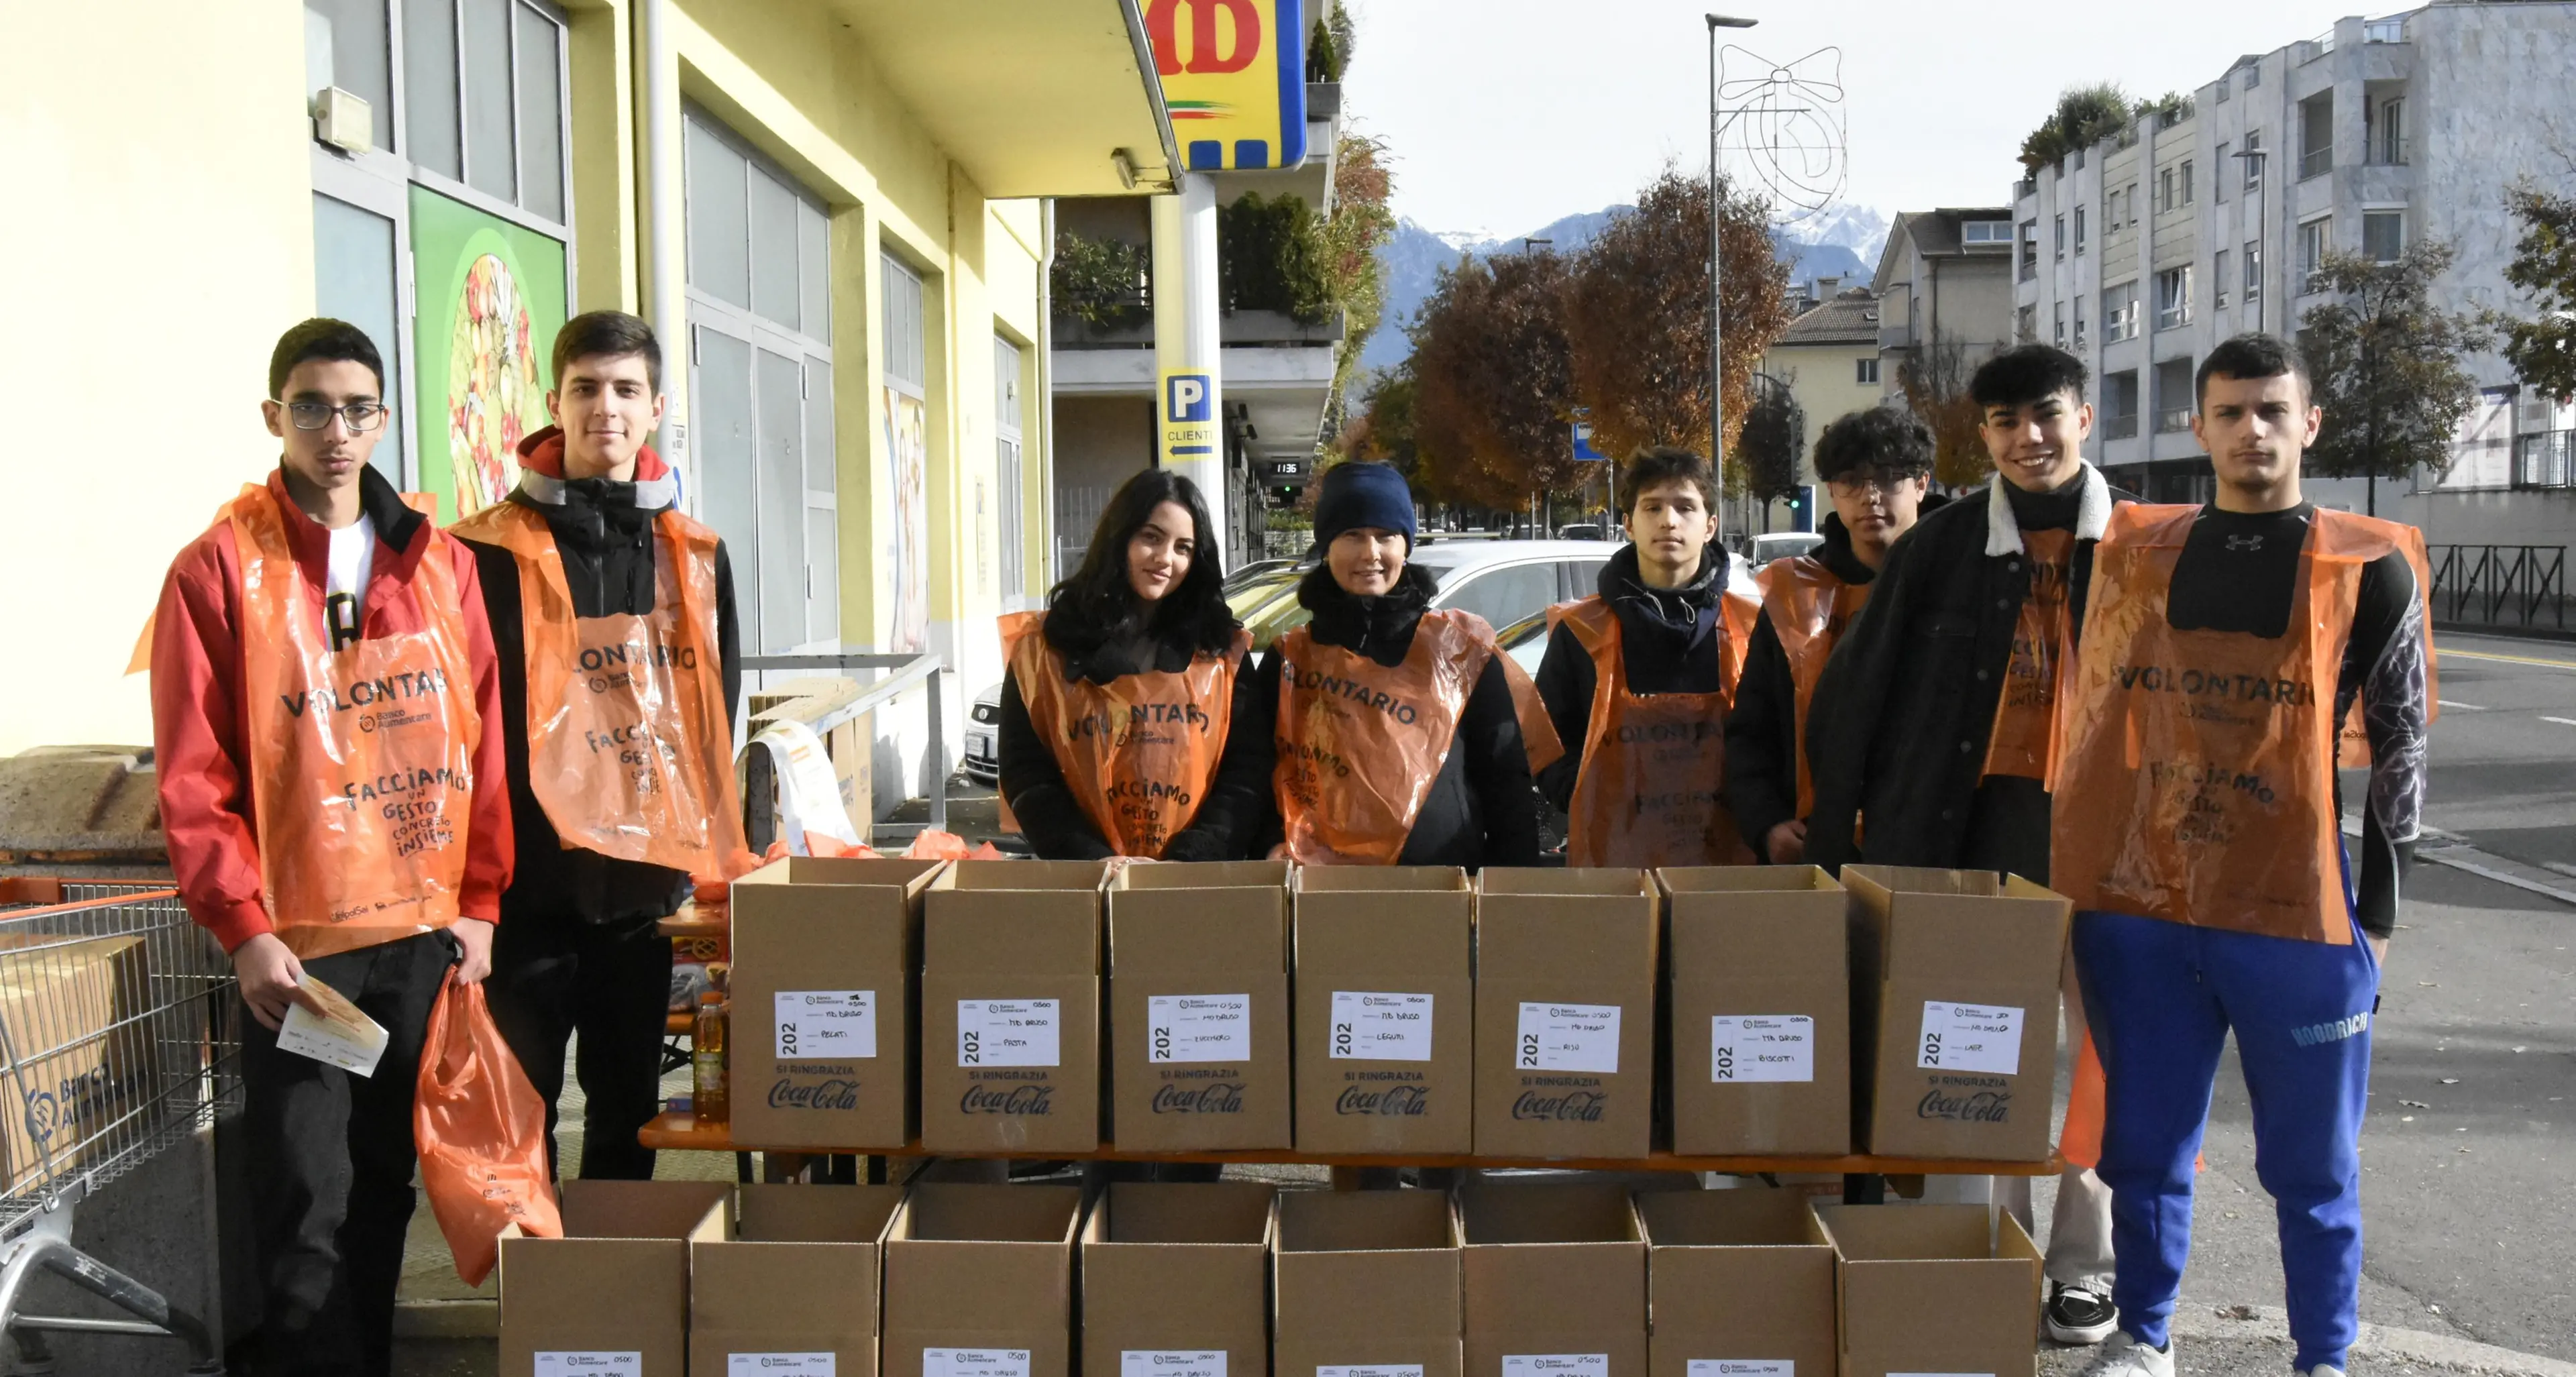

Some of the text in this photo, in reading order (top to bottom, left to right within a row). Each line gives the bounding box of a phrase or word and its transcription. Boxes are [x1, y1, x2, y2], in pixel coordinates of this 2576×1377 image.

[1174, 380, 1203, 417] P
[1167, 430, 1213, 441] CLIENTI
[408, 789, 425, 800] UN
[382, 801, 436, 822] GESTO
[393, 815, 450, 840] CONCRETO
[782, 1023, 797, 1055] 202
[965, 1032, 979, 1063] 202
[1155, 1028, 1170, 1059] 202
[1336, 1023, 1352, 1055] 202
[1523, 1034, 1538, 1066] 202
[1924, 1033, 1941, 1065] 202
[776, 1065, 855, 1075] SI RINGRAZIA
[969, 1071, 1047, 1081] SI RINGRAZIA
[1160, 1069, 1238, 1079] SI RINGRAZIA
[1344, 1072, 1424, 1081] SI RINGRAZIA
[1718, 1046, 1733, 1079] 202
[768, 1079, 860, 1109] Coca-Cola
[1521, 1077, 1601, 1087] SI RINGRAZIA
[1929, 1076, 2006, 1087] SI RINGRAZIA
[961, 1085, 1055, 1115] Coca-Cola
[1152, 1083, 1246, 1114] Coca-Cola
[1336, 1085, 1430, 1115] Coca-Cola
[1513, 1091, 1608, 1122] Coca-Cola
[1917, 1089, 2014, 1122] Coca-Cola
